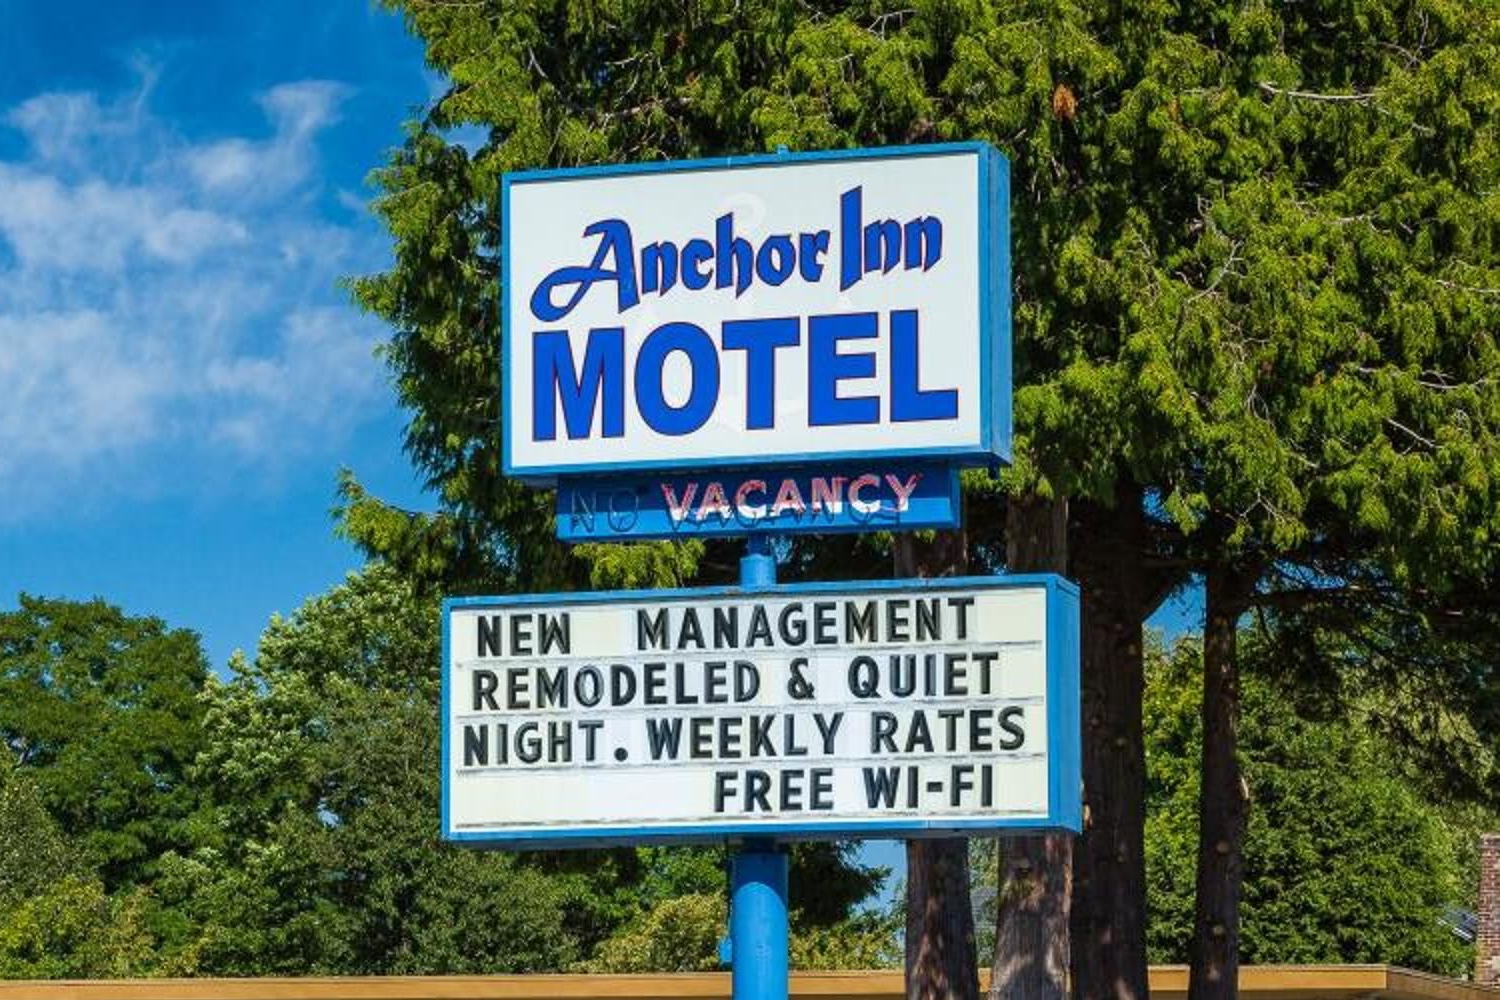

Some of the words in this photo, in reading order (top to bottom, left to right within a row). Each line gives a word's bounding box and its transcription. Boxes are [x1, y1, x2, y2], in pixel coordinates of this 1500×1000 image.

[529, 211, 831, 323] Anchor
[839, 185, 943, 292] Inn
[532, 309, 959, 442] MOTEL
[569, 485, 640, 533] NO
[661, 472, 924, 521] VACANCY
[476, 612, 571, 657] NEW
[638, 597, 975, 650] MANAGEMENT
[472, 660, 760, 711] REMODELED
[787, 657, 815, 700] &
[848, 651, 999, 696] QUIET
[647, 711, 845, 762] WEEKLY
[871, 706, 1026, 754] RATES
[714, 767, 834, 813] FREE
[863, 764, 994, 809] WI-FI
